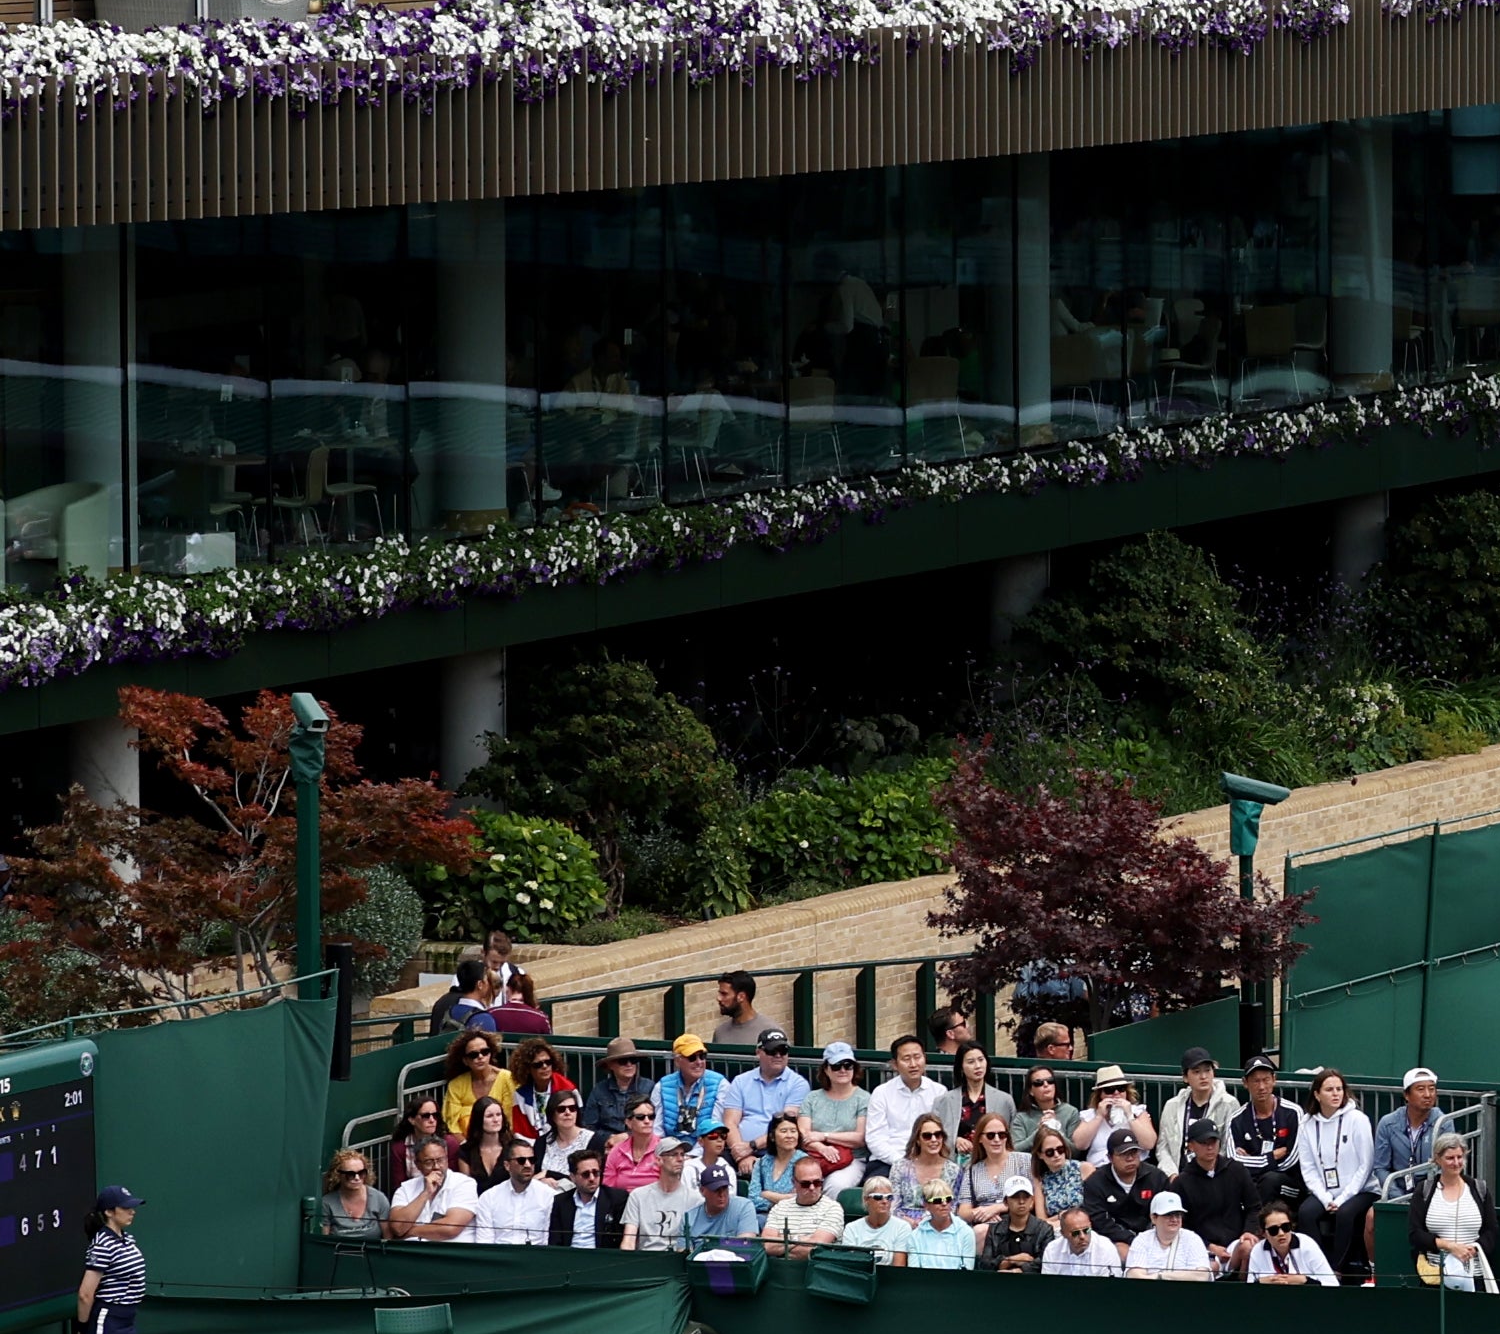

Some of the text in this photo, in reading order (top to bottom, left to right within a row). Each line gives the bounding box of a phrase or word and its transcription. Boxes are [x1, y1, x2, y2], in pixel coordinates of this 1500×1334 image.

[64, 1090, 83, 1108] 2:01
[19, 1146, 57, 1172] 4 7 1
[21, 1209, 60, 1236] 6 5 3
